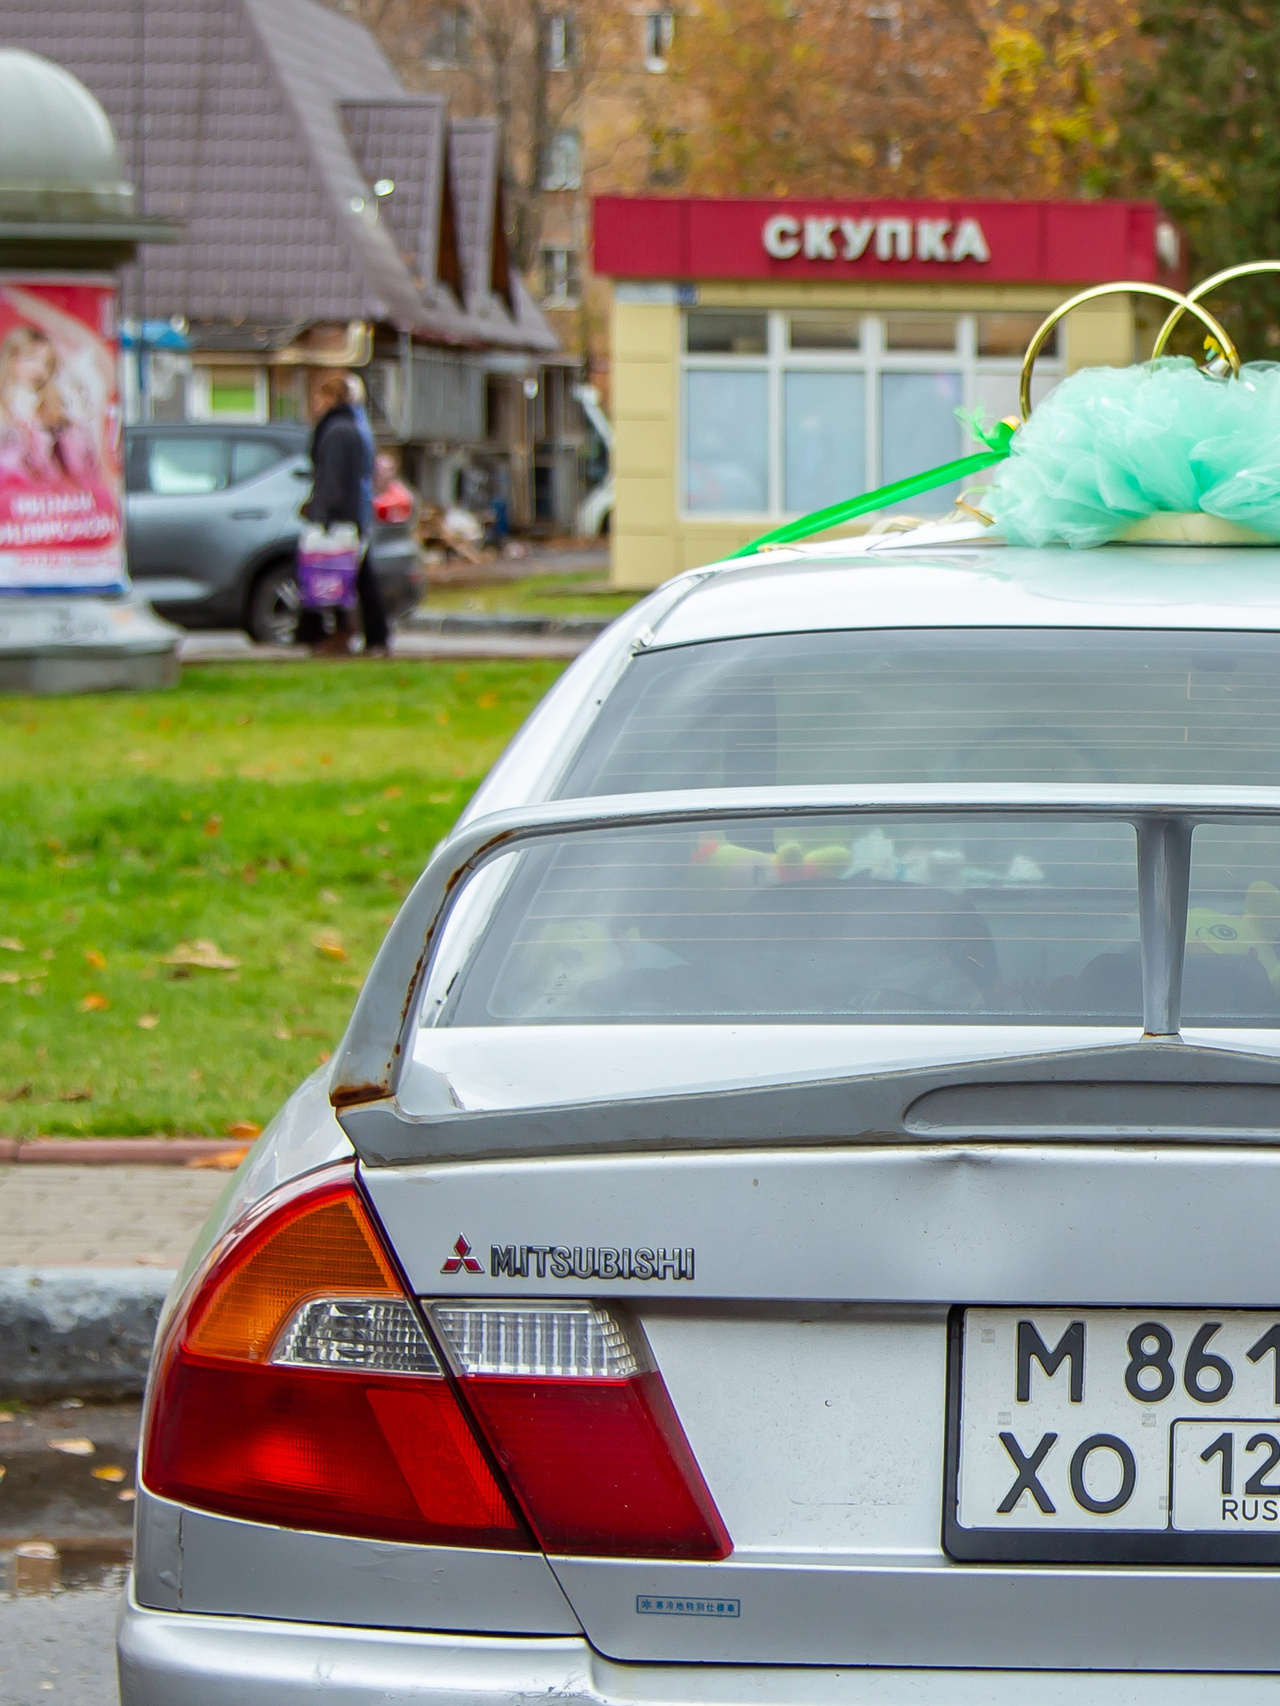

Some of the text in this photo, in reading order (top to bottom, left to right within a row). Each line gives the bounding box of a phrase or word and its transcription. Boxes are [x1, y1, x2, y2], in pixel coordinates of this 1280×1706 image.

[763, 214, 990, 262] СКУПКА
[490, 1244, 694, 1280] MITSUBISHI
[1222, 1500, 1278, 1521] RUS
